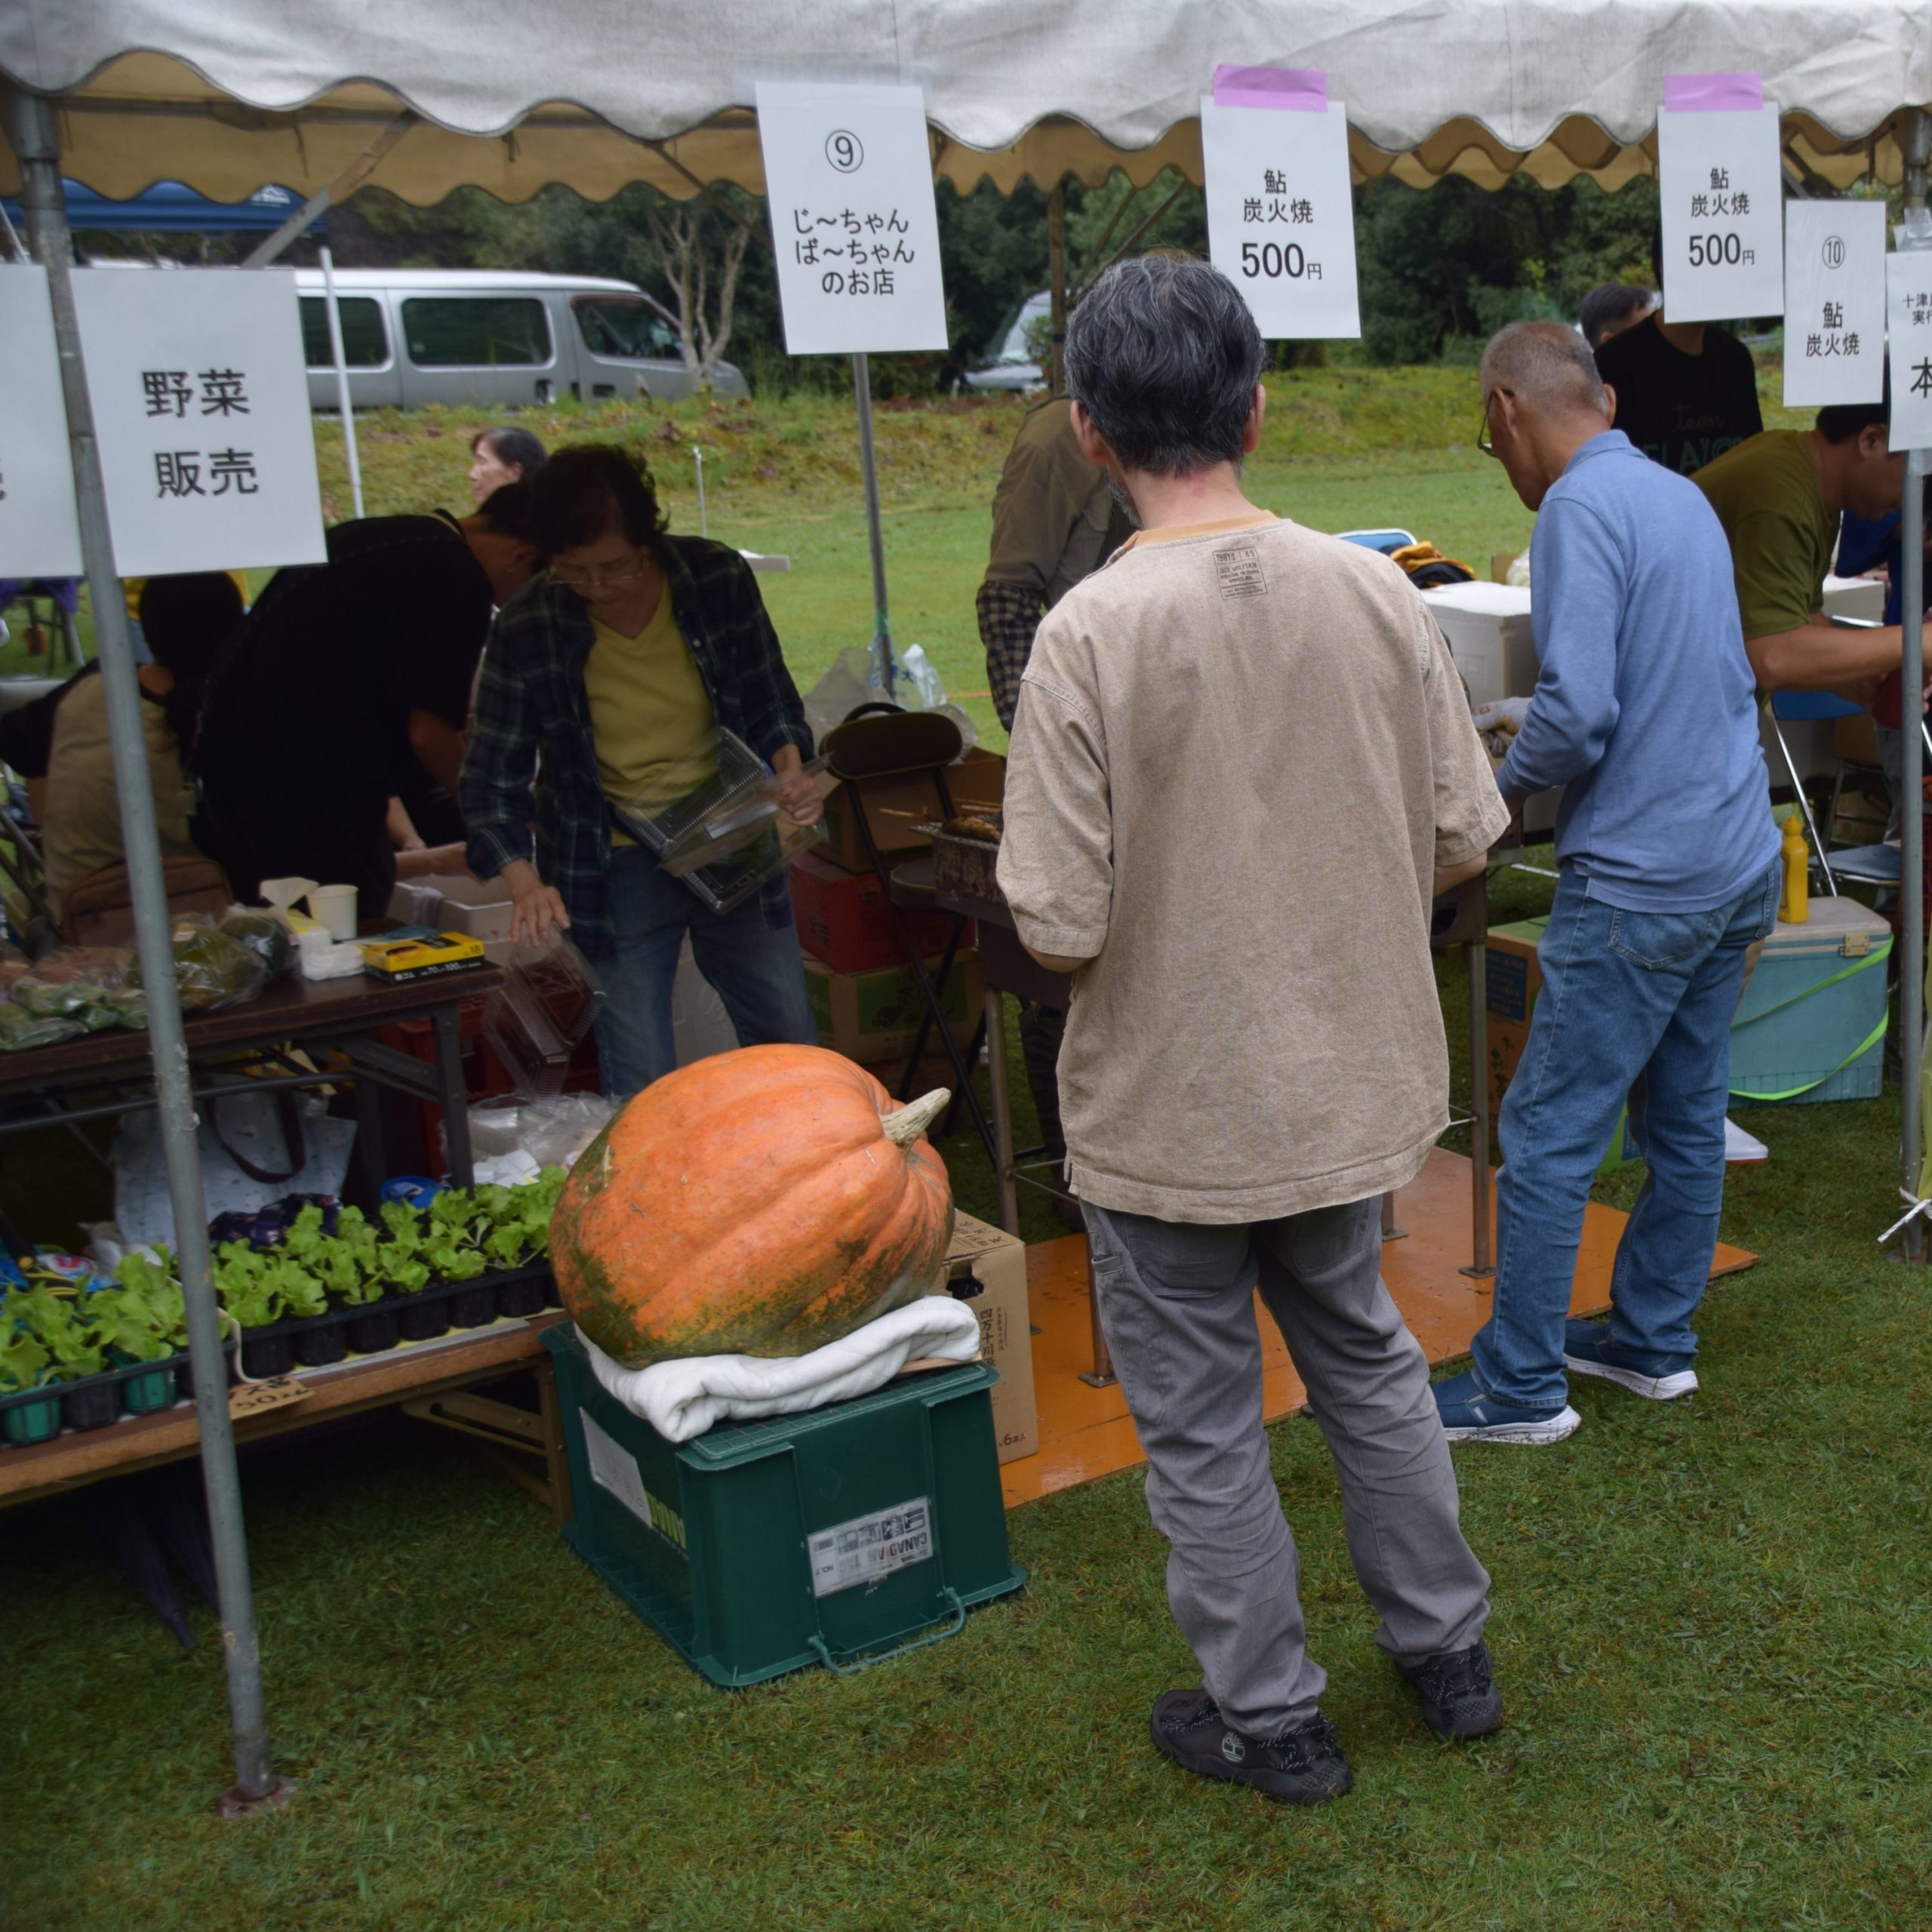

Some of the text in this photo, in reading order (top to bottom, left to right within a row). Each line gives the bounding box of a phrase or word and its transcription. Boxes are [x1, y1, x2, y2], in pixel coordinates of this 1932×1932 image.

[1264, 169, 1287, 195] 鮎
[1709, 168, 1729, 190] 鮎
[1243, 198, 1314, 224] 炭火焼
[1690, 192, 1750, 217] 炭火焼
[821, 268, 895, 296] のお店
[1902, 293, 1932, 309] 十津
[1823, 302, 1843, 329] 鮎
[1806, 332, 1860, 358] 炭火焼
[142, 368, 251, 419] 野菜
[155, 448, 260, 499] 販売
